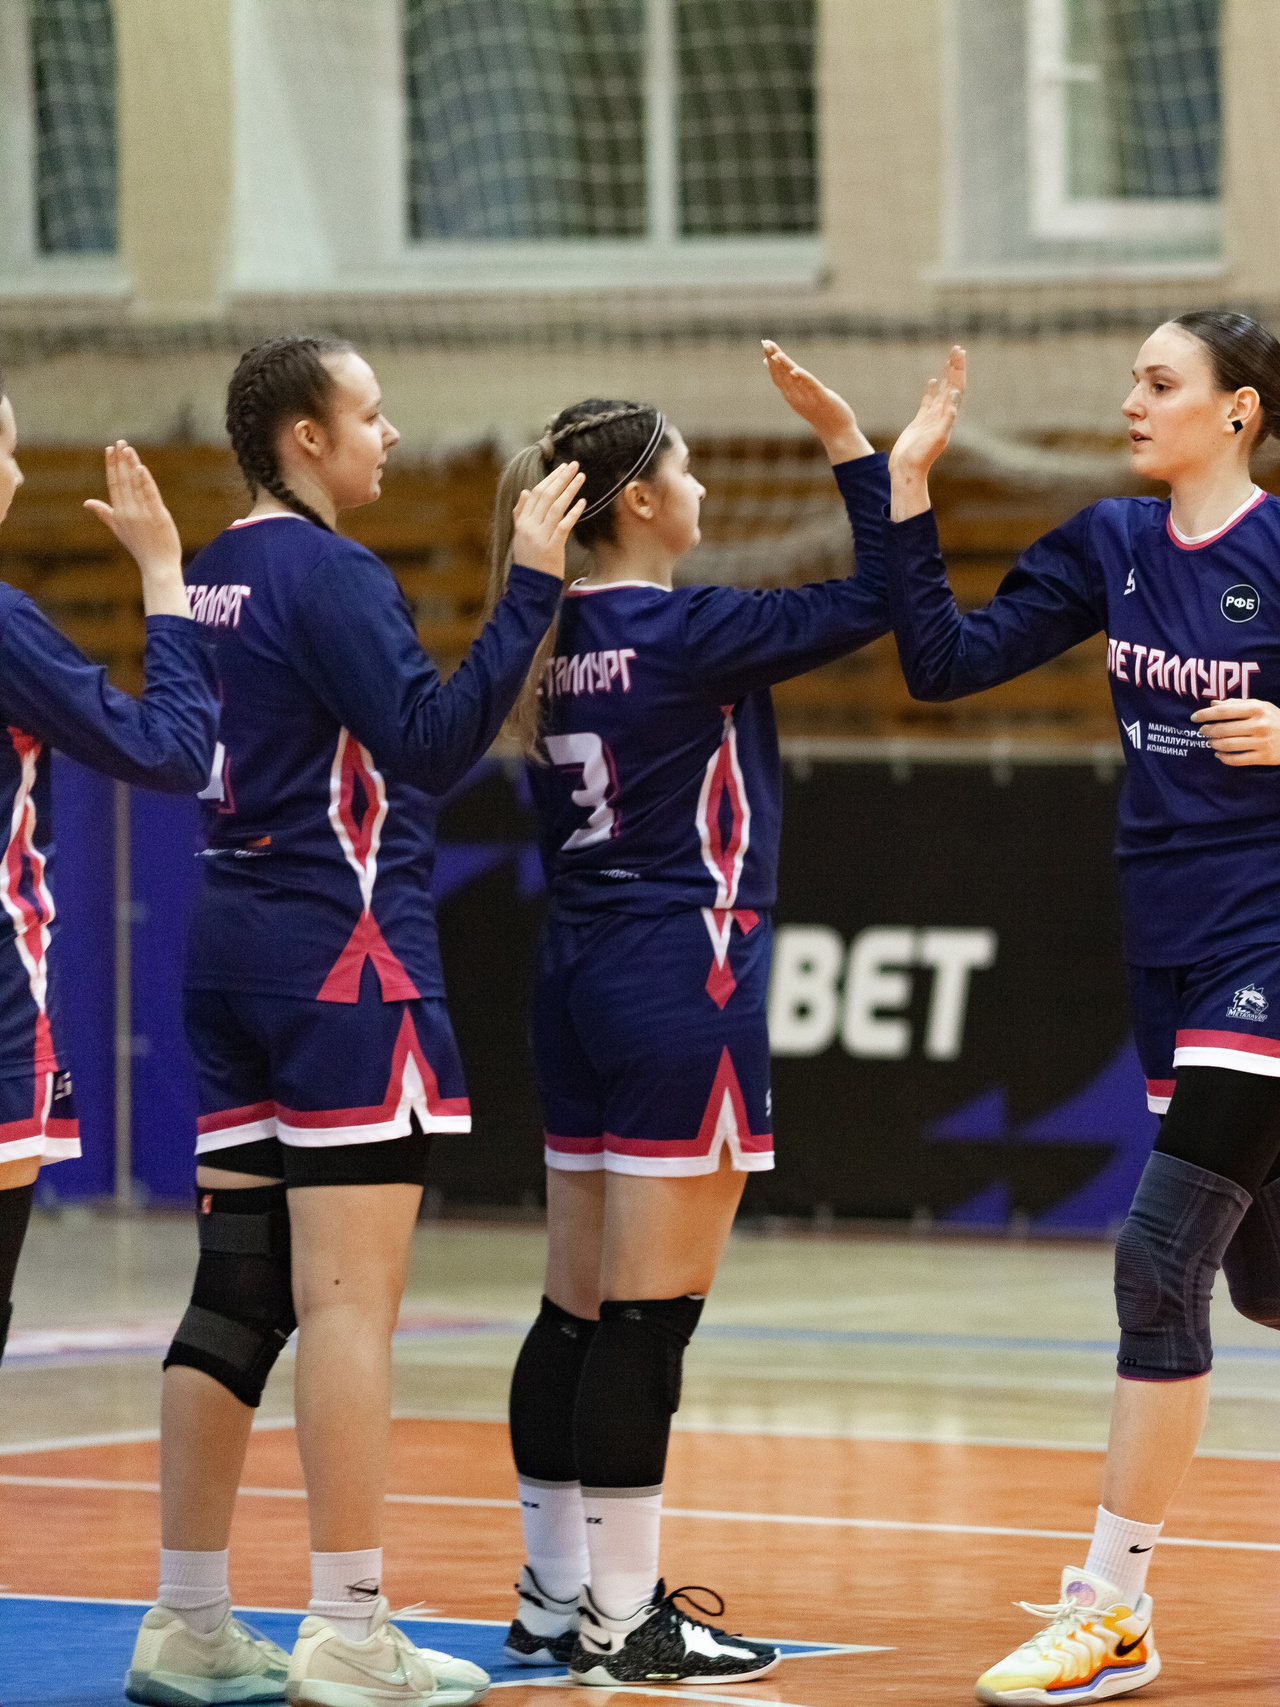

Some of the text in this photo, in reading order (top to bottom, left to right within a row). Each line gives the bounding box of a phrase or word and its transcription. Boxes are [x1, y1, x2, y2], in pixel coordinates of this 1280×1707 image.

[1225, 595, 1255, 610] РФБ
[1146, 743, 1188, 757] КОМБИНАТ
[543, 732, 619, 851] 3
[767, 925, 998, 1061] BET
